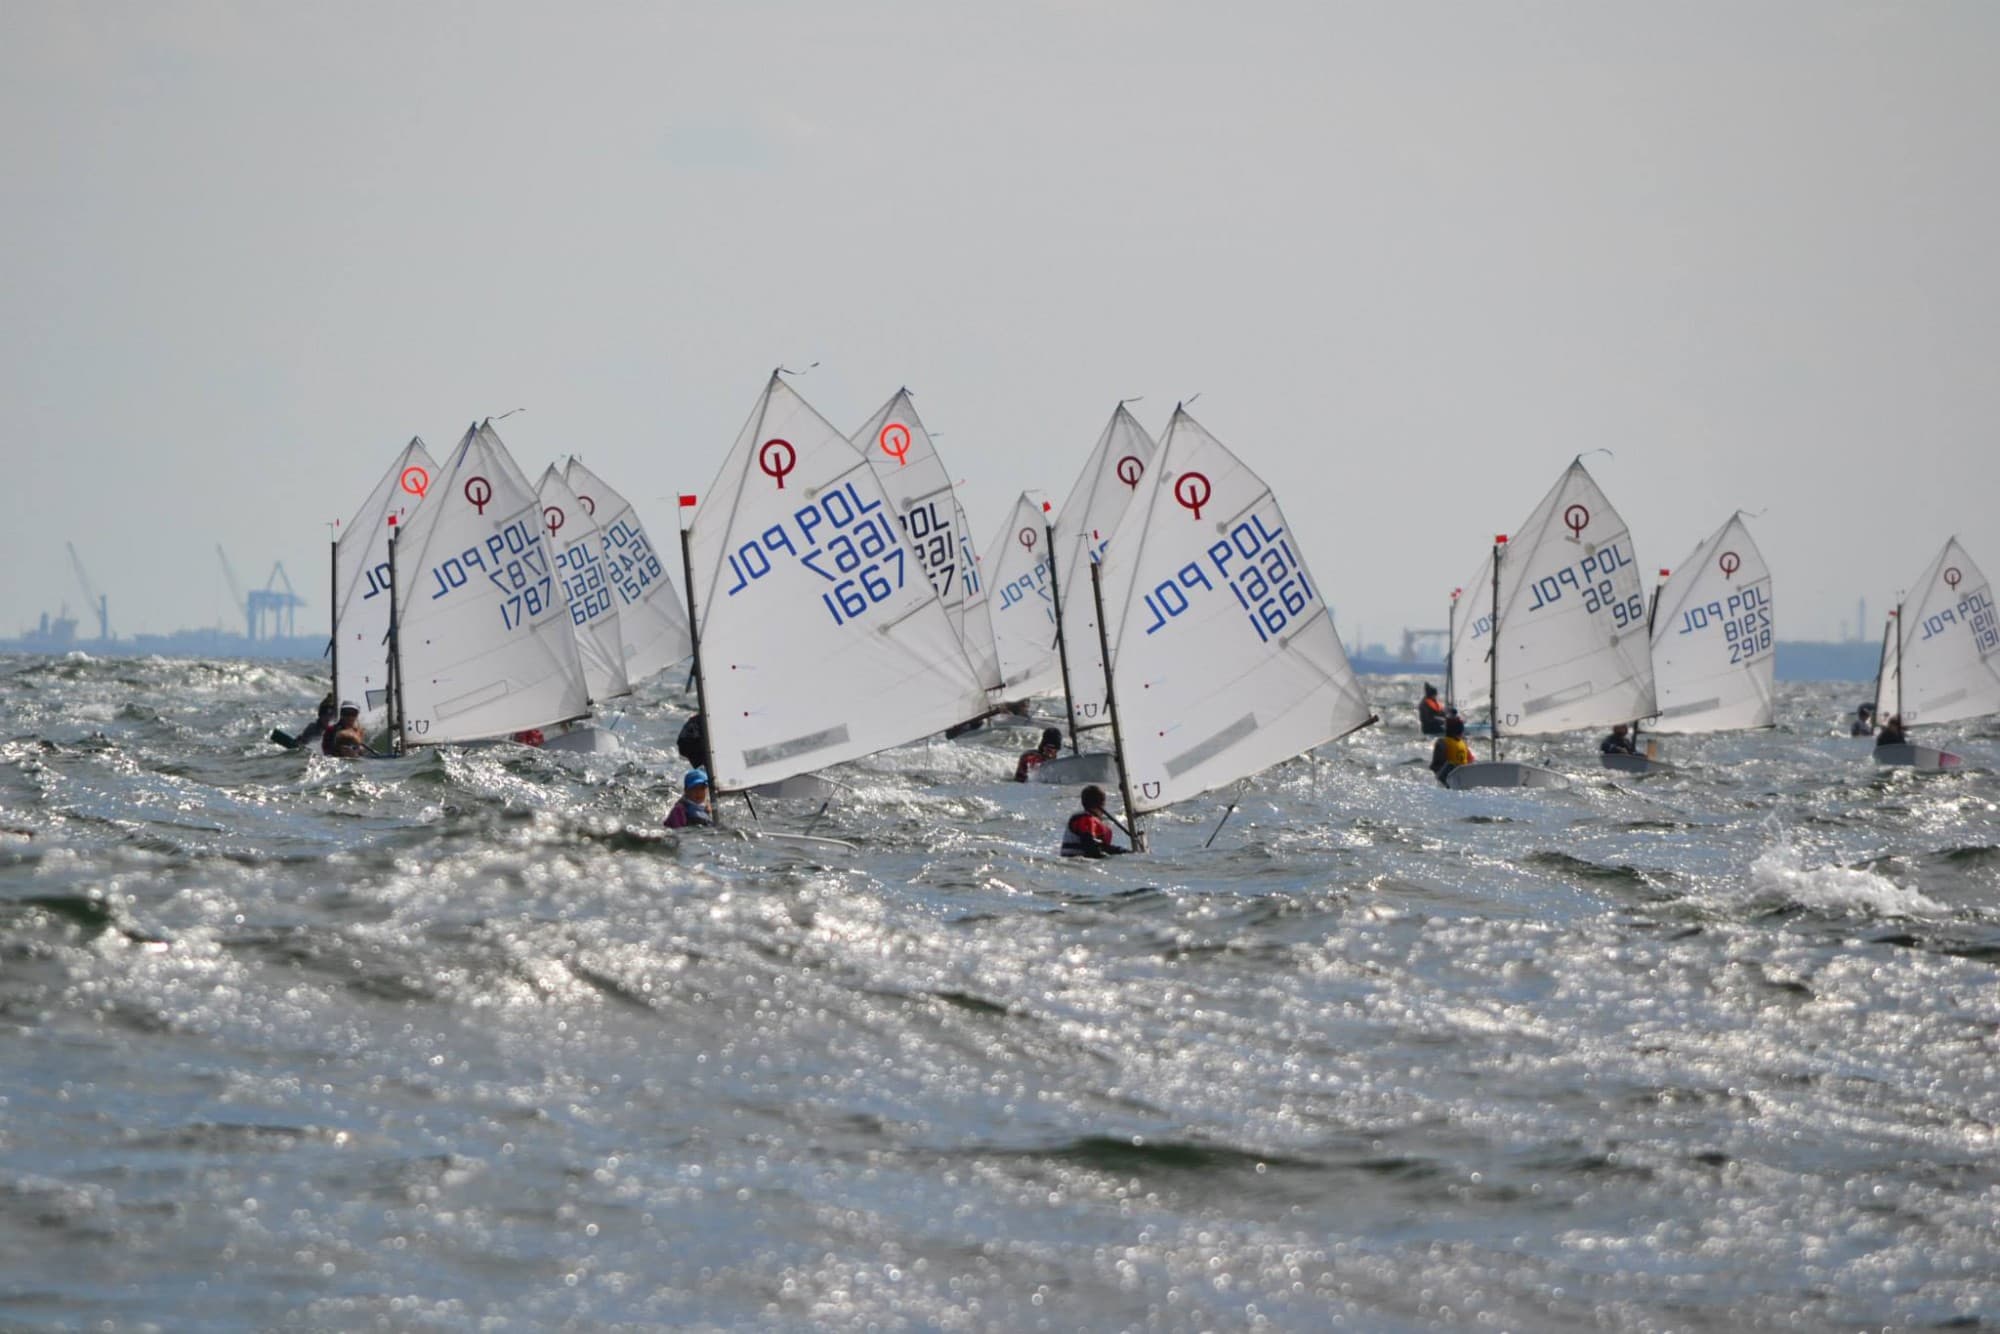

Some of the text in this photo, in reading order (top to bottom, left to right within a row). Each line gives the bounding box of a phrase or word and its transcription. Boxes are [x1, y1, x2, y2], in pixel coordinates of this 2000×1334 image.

[794, 482, 881, 546] POL
[486, 520, 540, 565] POL
[1207, 514, 1283, 578] POL
[1580, 544, 1632, 584] POL
[617, 555, 662, 605] 1548
[822, 547, 905, 627] 1667
[1727, 586, 1769, 617] POL
[500, 575, 551, 631] 1787
[570, 587, 611, 626] 660
[1249, 571, 1314, 643] 1661
[1612, 594, 1643, 629] 96
[1956, 593, 1993, 620] POL
[1727, 628, 1771, 664] 2918
